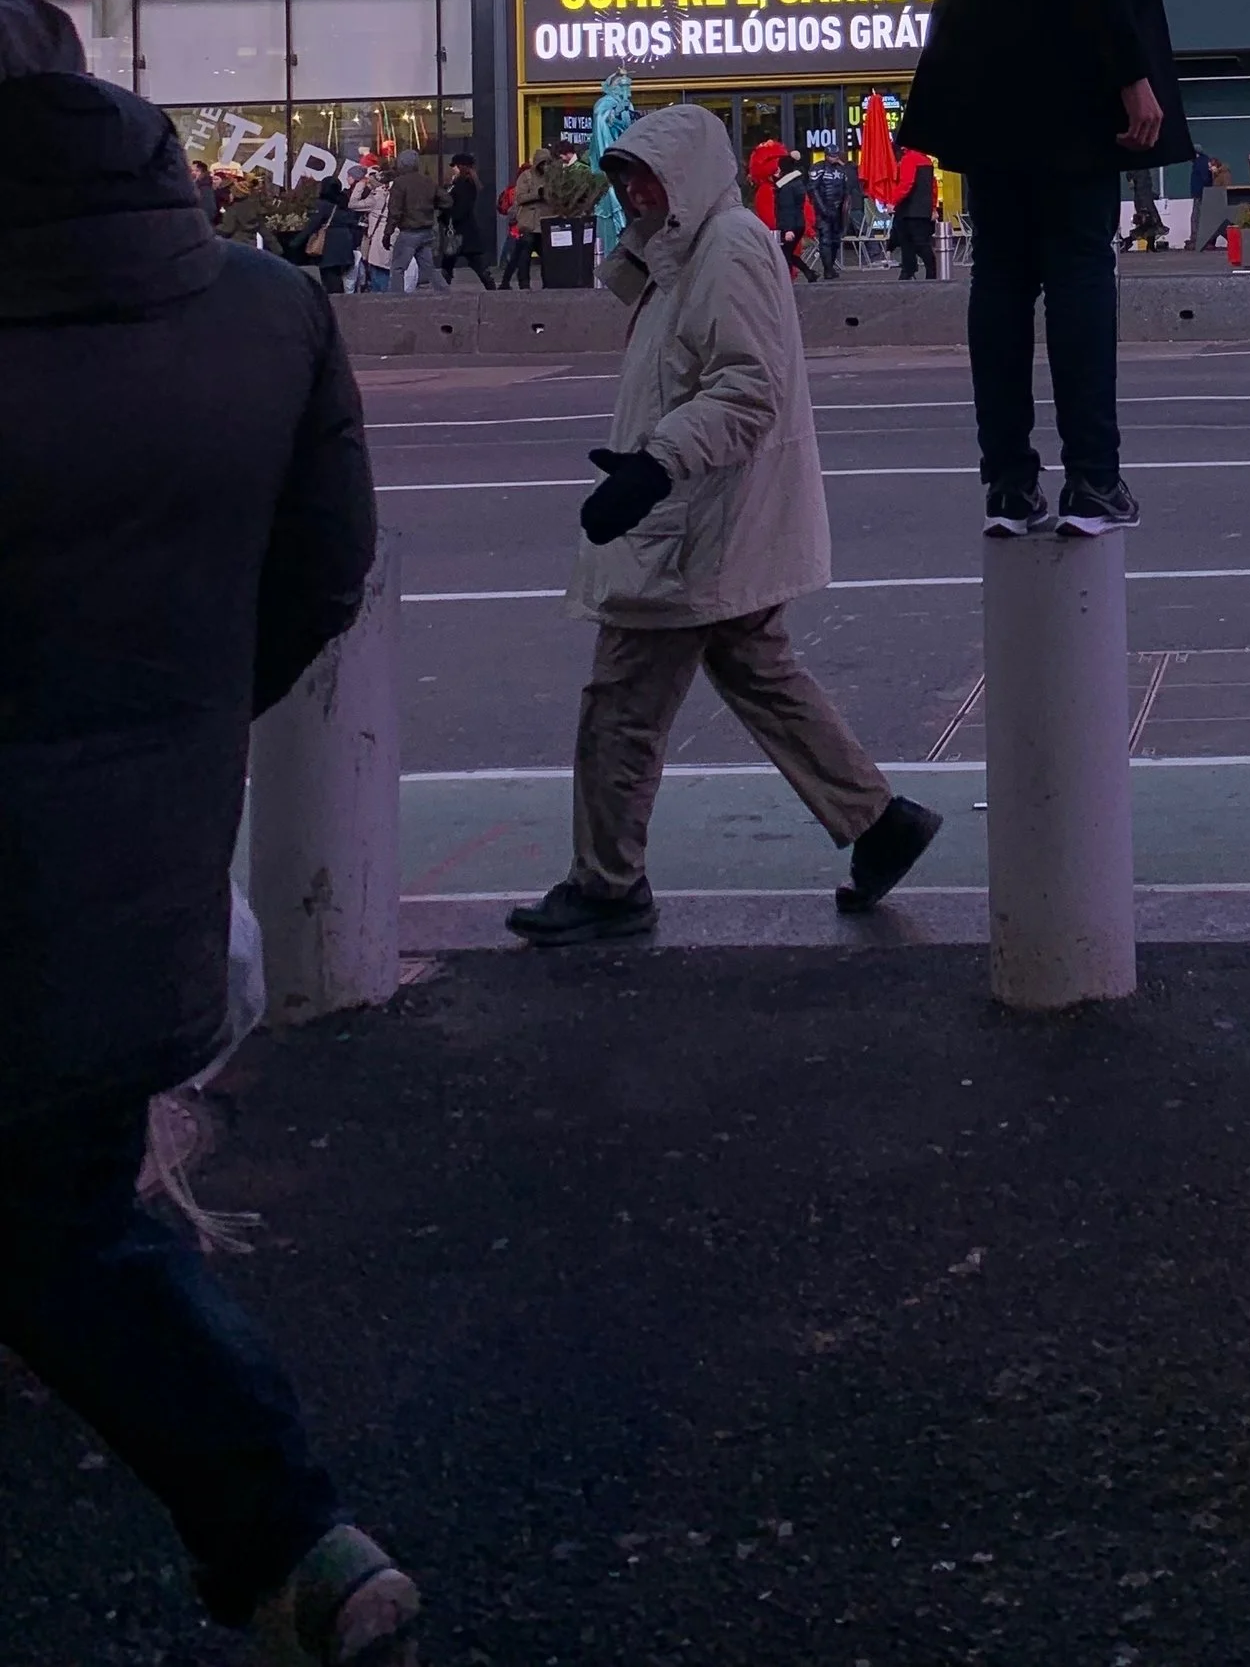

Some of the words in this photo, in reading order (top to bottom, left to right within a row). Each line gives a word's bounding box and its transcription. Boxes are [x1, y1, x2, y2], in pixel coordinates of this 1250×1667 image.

[535, 20, 672, 59] OUTROS
[681, 9, 842, 55] RELÓGIOS
[185, 108, 222, 151] THE
[563, 116, 577, 129] NEW
